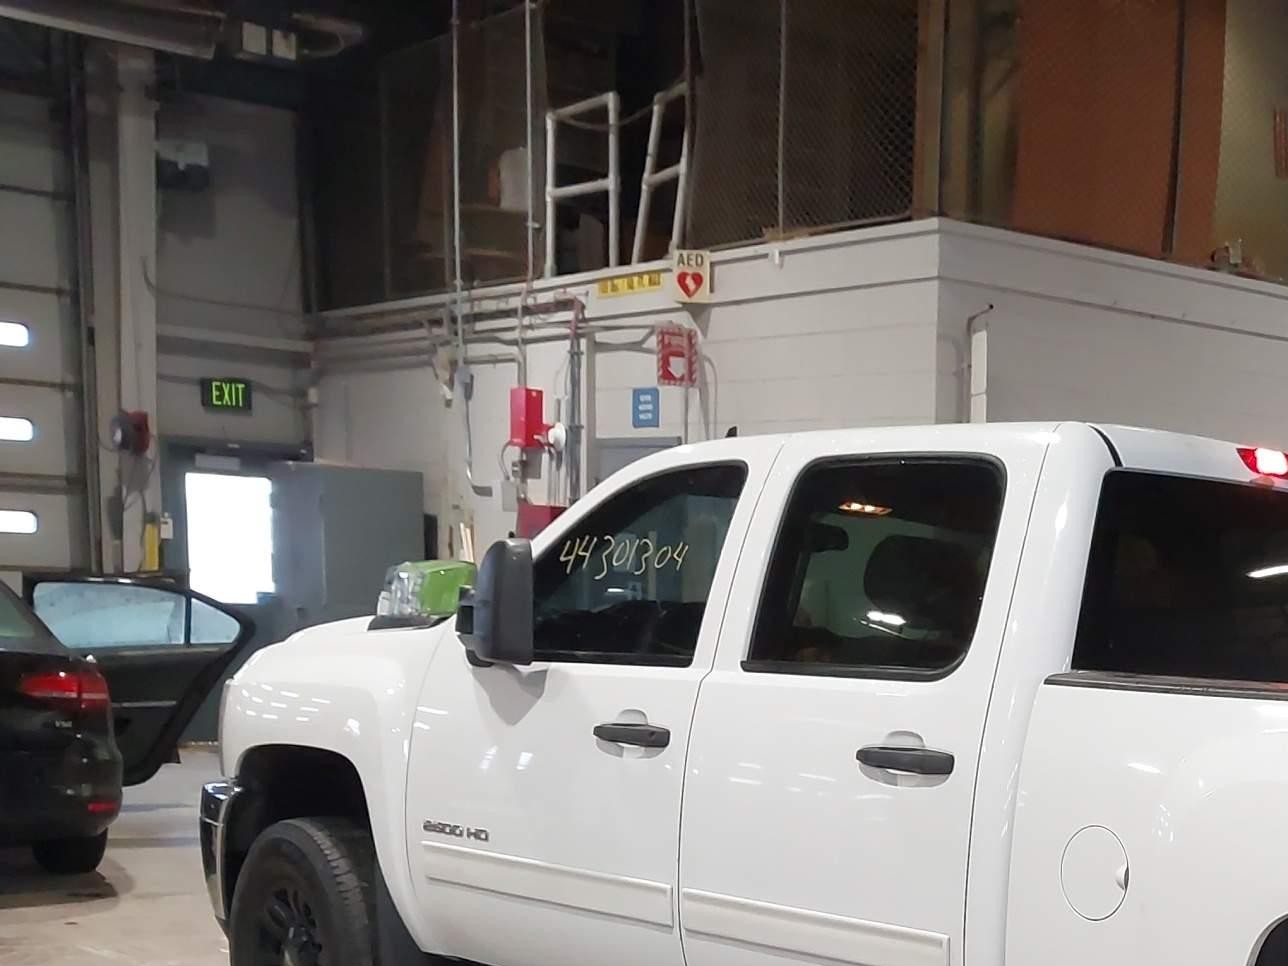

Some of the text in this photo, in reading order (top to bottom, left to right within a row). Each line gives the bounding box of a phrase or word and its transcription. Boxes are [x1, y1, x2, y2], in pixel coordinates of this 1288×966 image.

[676, 252, 704, 268] AED
[212, 381, 245, 407] EXIT
[559, 535, 689, 580] 44301304
[467, 828, 489, 842] HD
